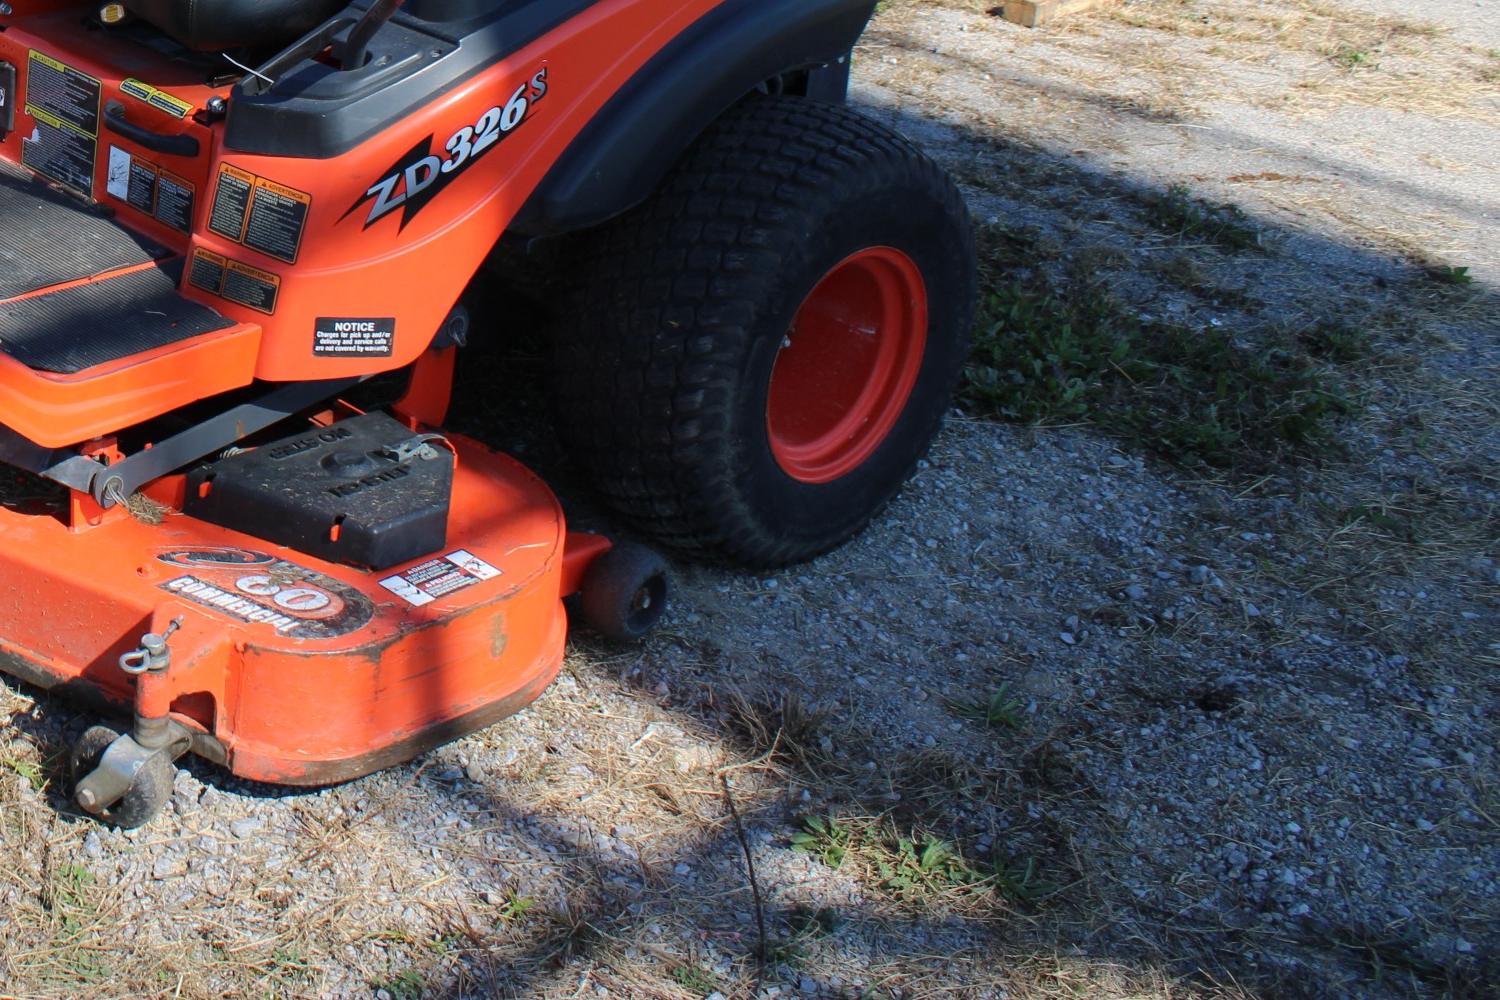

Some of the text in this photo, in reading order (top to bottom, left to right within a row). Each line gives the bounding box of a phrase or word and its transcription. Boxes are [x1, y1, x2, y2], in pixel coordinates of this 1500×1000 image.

[37, 56, 58, 69] CAUTION
[229, 169, 251, 181] WARNING
[268, 183, 303, 200] ADVERTENCIA
[236, 264, 274, 282] ADVERTENCIA
[334, 322, 375, 332] NOTICE
[316, 331, 339, 339] Charges
[349, 331, 362, 339] pick
[319, 338, 341, 346] delivery
[411, 559, 442, 574] DANGER
[429, 571, 461, 587] PELIGRO
[235, 574, 331, 611] 60
[168, 576, 301, 632] COMMERCIAL
